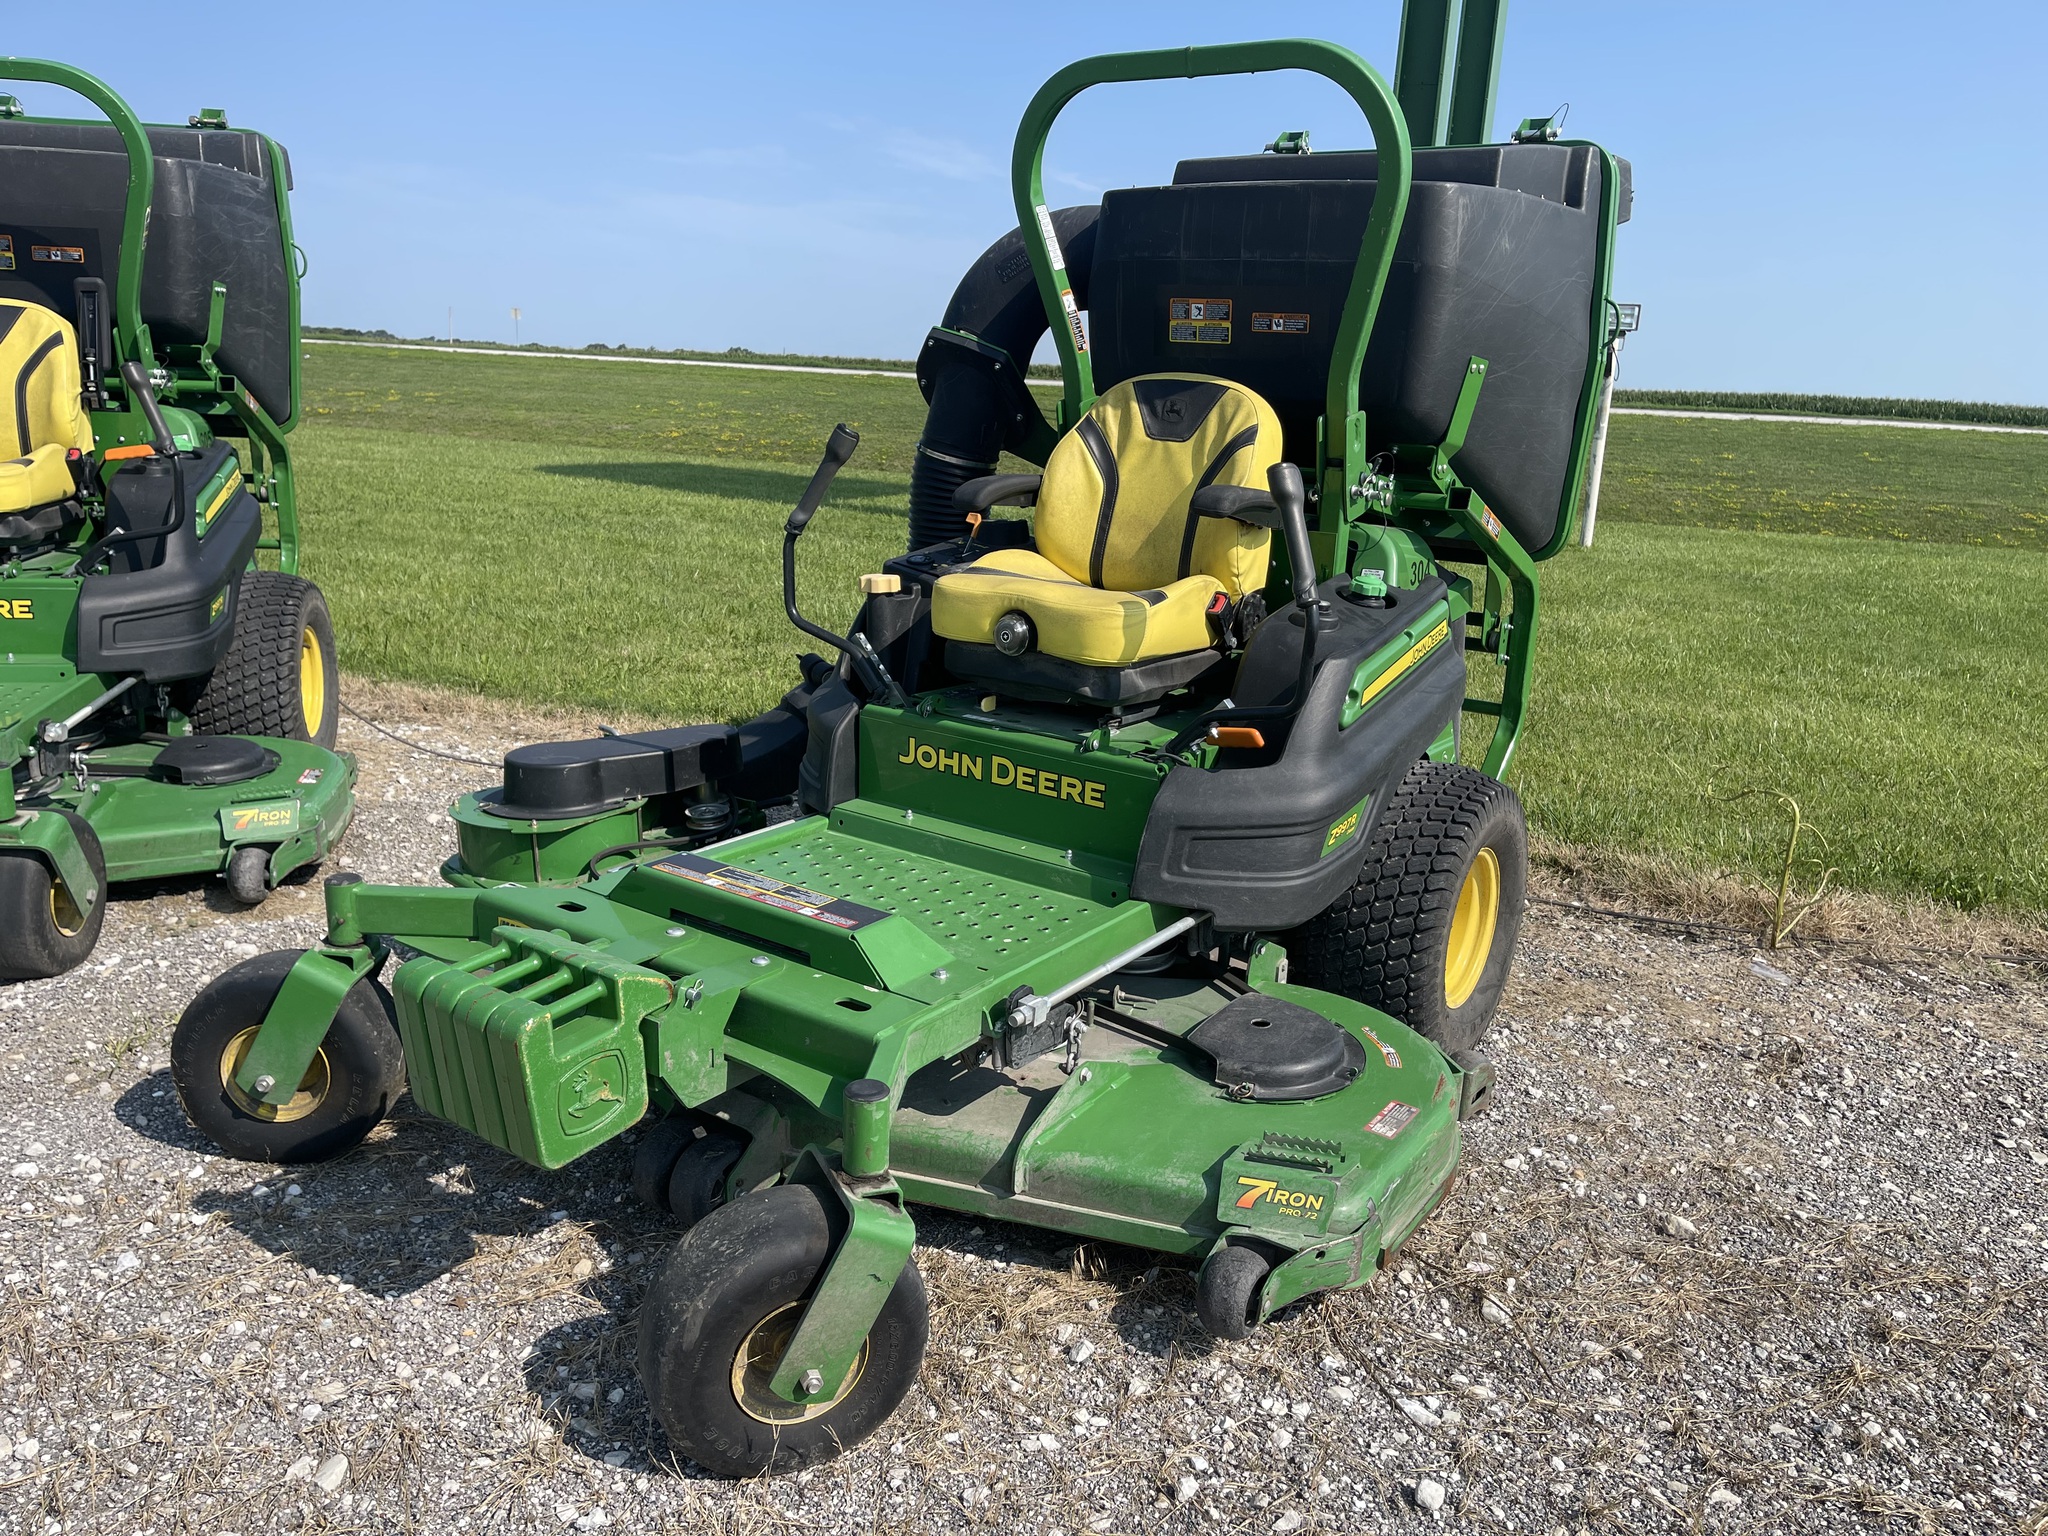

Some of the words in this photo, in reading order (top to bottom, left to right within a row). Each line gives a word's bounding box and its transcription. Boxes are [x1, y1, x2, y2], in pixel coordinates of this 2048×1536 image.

[1410, 642, 1427, 665] JOHN
[1427, 625, 1446, 649] DEERE
[898, 736, 983, 782] JOHN
[990, 754, 1107, 810] DEERE
[1328, 812, 1359, 847] Z997R
[1264, 1187, 1325, 1212] IRON
[1278, 1206, 1302, 1218] PRO
[1304, 1211, 1318, 1221] 72
